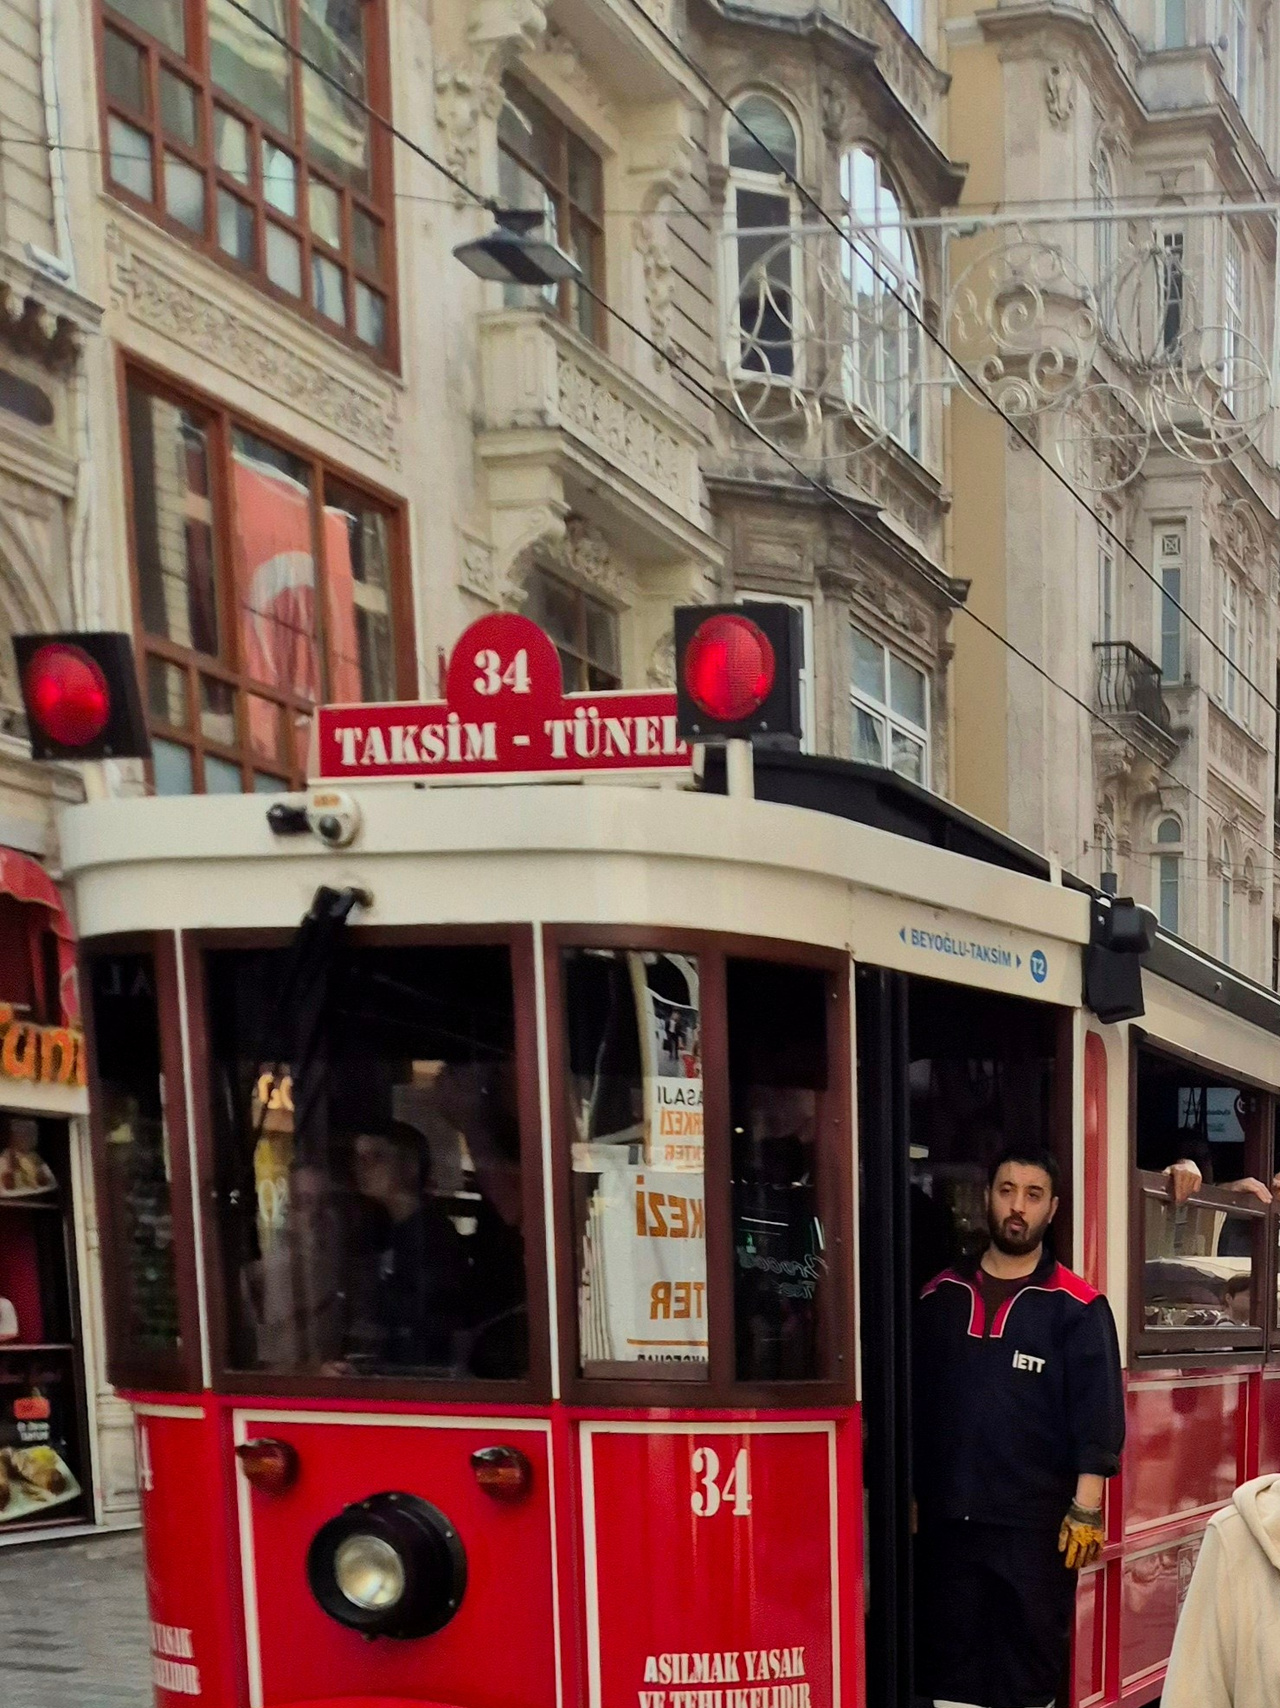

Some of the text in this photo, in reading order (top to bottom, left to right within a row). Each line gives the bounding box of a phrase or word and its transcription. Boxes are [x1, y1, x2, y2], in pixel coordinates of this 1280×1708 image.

[472, 647, 532, 696] 34
[335, 711, 498, 767] TAKSİM
[544, 706, 688, 760] TÜNEL
[1031, 956, 1046, 976] T2
[1012, 1350, 1046, 1373] İETT
[691, 1446, 752, 1517] 34
[643, 1646, 805, 1685] ASILMAK YASAK
